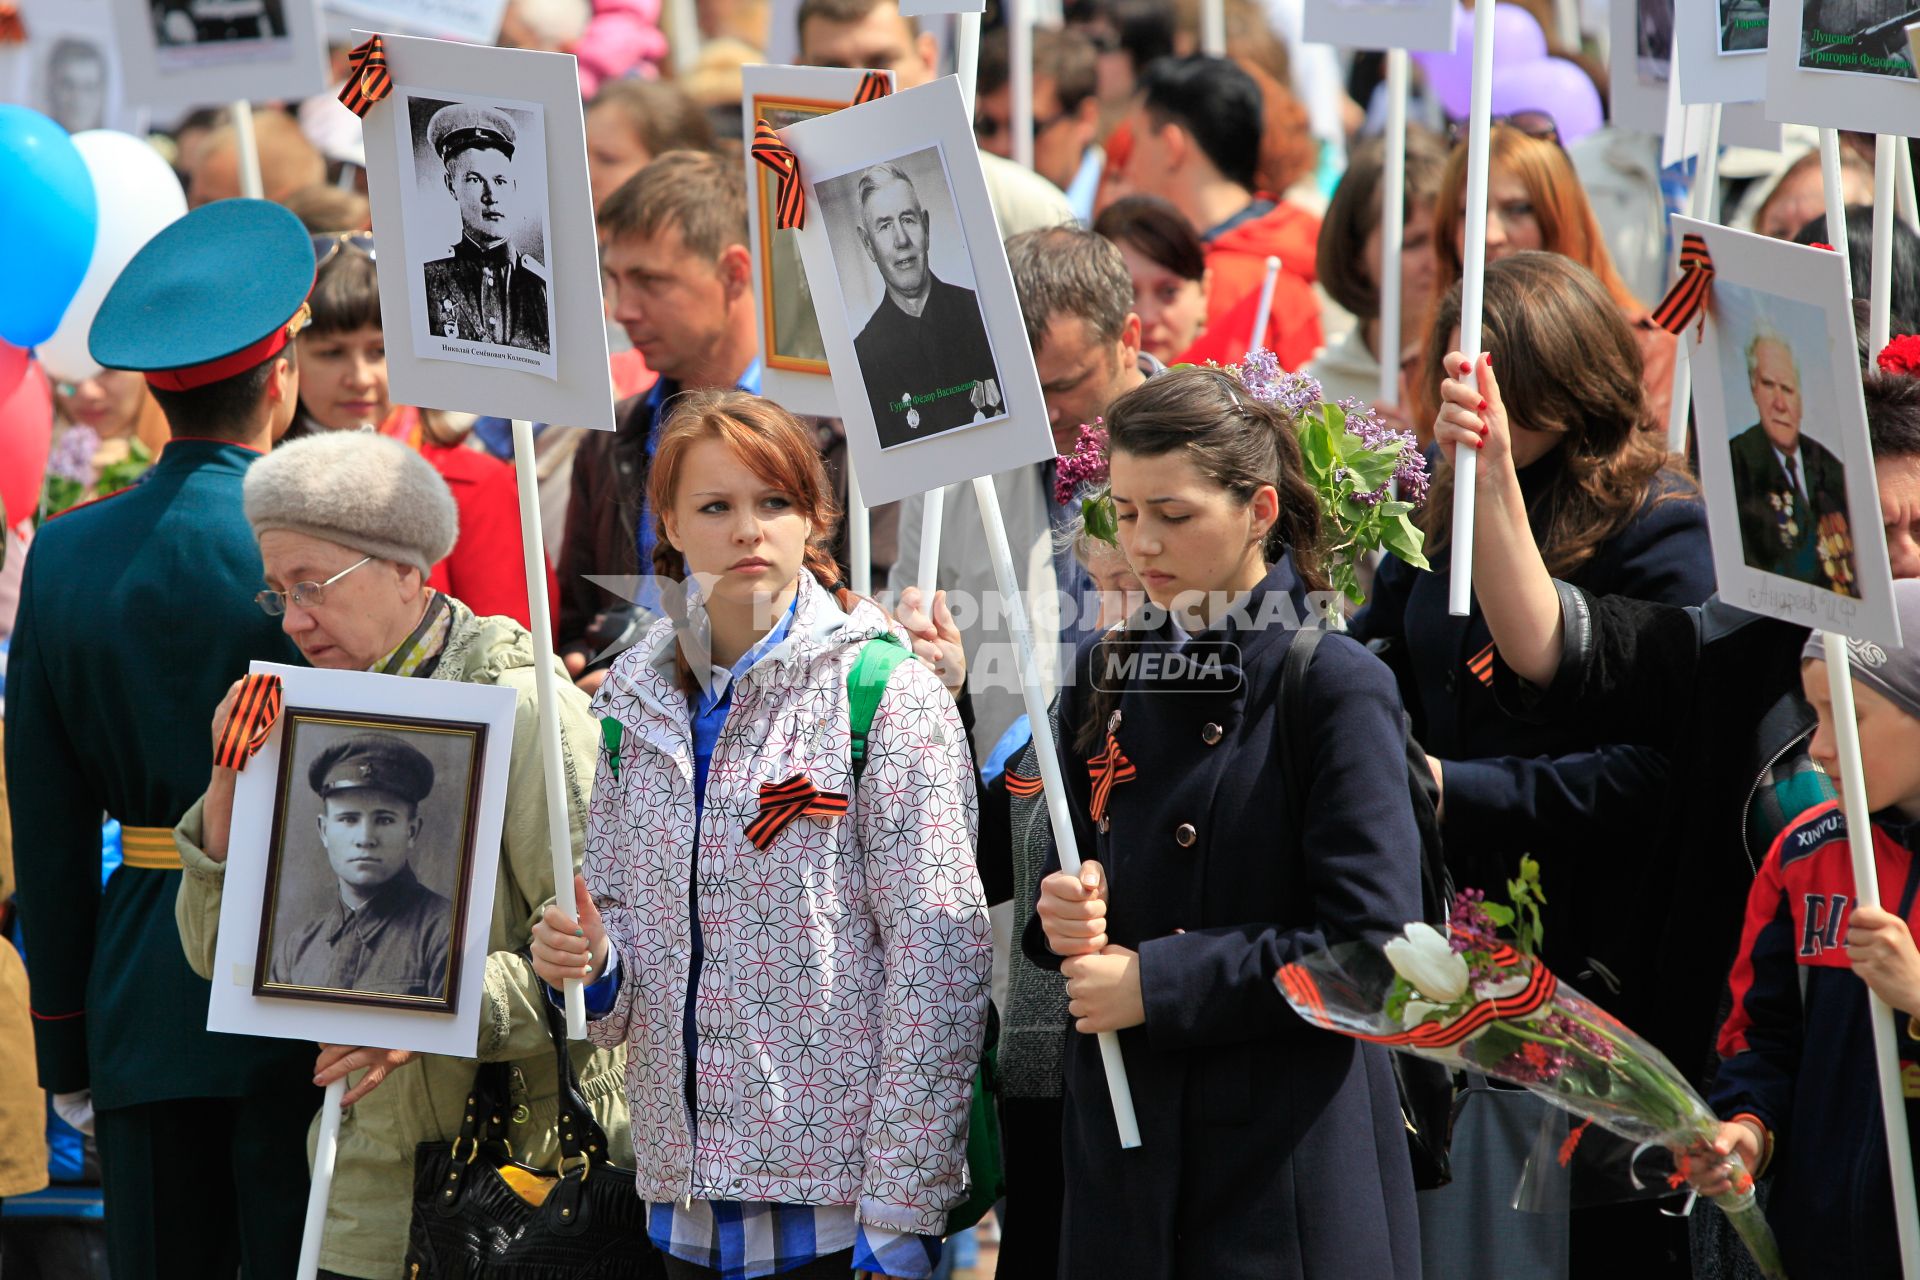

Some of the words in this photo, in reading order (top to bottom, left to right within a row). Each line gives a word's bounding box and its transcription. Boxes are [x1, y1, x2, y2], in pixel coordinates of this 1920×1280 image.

[1811, 29, 1854, 44] Луценко
[1811, 48, 1857, 64] Григорий
[442, 344, 470, 355] Николай
